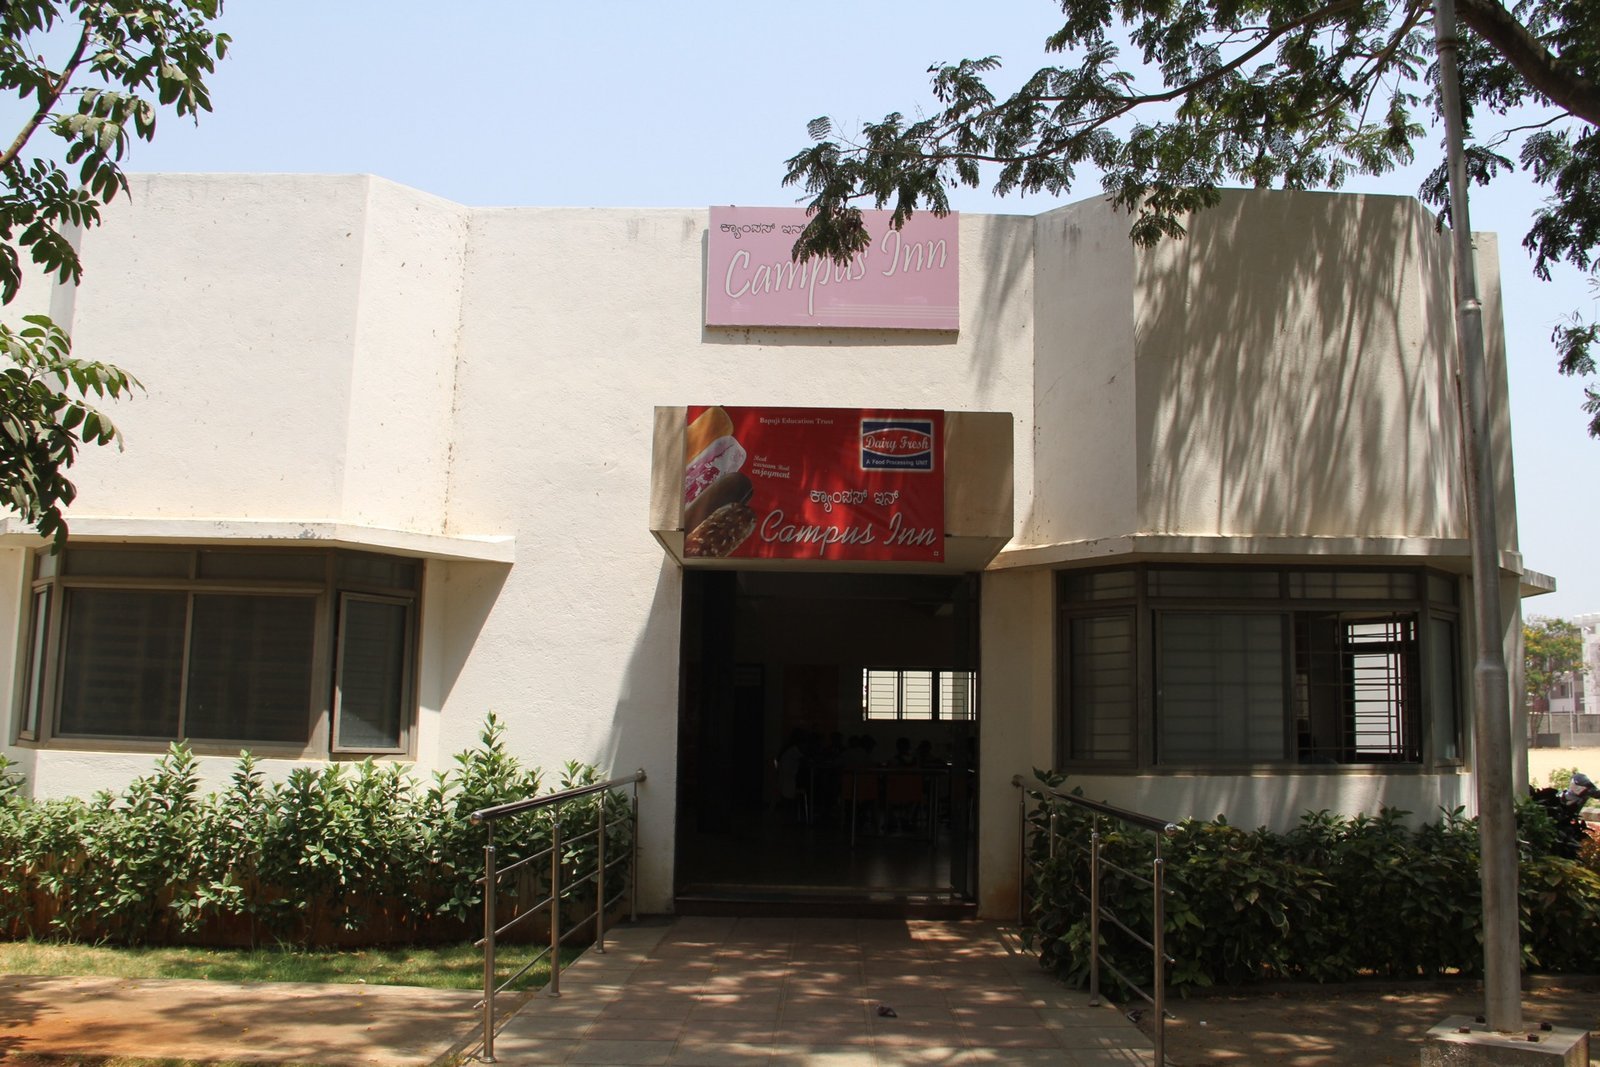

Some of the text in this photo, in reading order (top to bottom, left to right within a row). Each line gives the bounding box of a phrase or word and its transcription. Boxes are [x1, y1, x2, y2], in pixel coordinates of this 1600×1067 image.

[781, 223, 806, 234] ಇನ್
[725, 229, 947, 316] Campus Inn
[781, 417, 815, 425] Education
[815, 417, 834, 425] Trust
[865, 435, 929, 453] Dairy Fresh
[752, 468, 790, 479] enjoyment
[874, 490, 899, 505] ಇನ್
[760, 509, 937, 556] Campus Inn
